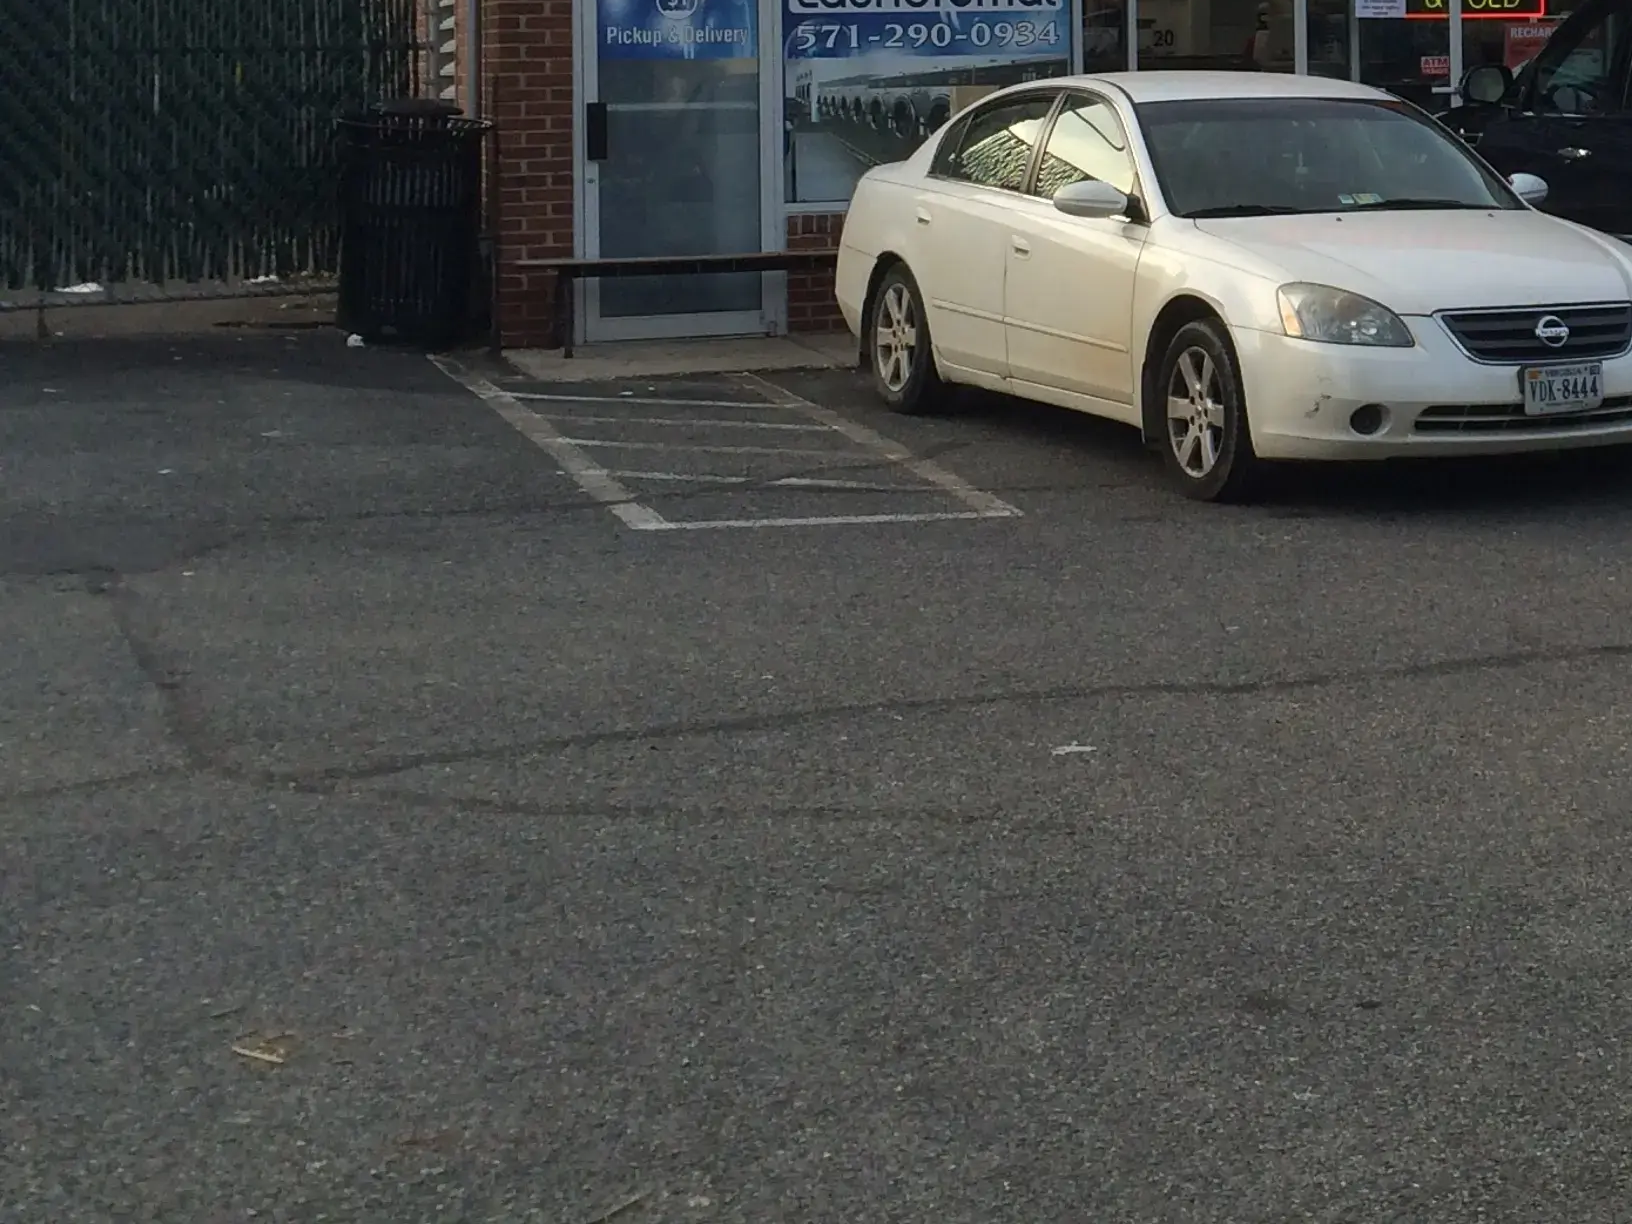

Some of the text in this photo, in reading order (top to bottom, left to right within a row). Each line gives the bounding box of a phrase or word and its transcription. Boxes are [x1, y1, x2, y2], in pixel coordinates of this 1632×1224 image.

[607, 26, 662, 47] Pickup
[684, 24, 748, 44] Delivery
[796, 21, 1060, 50] 571-290-0934
[1153, 29, 1174, 48] 20
[1510, 27, 1554, 39] RECHAR
